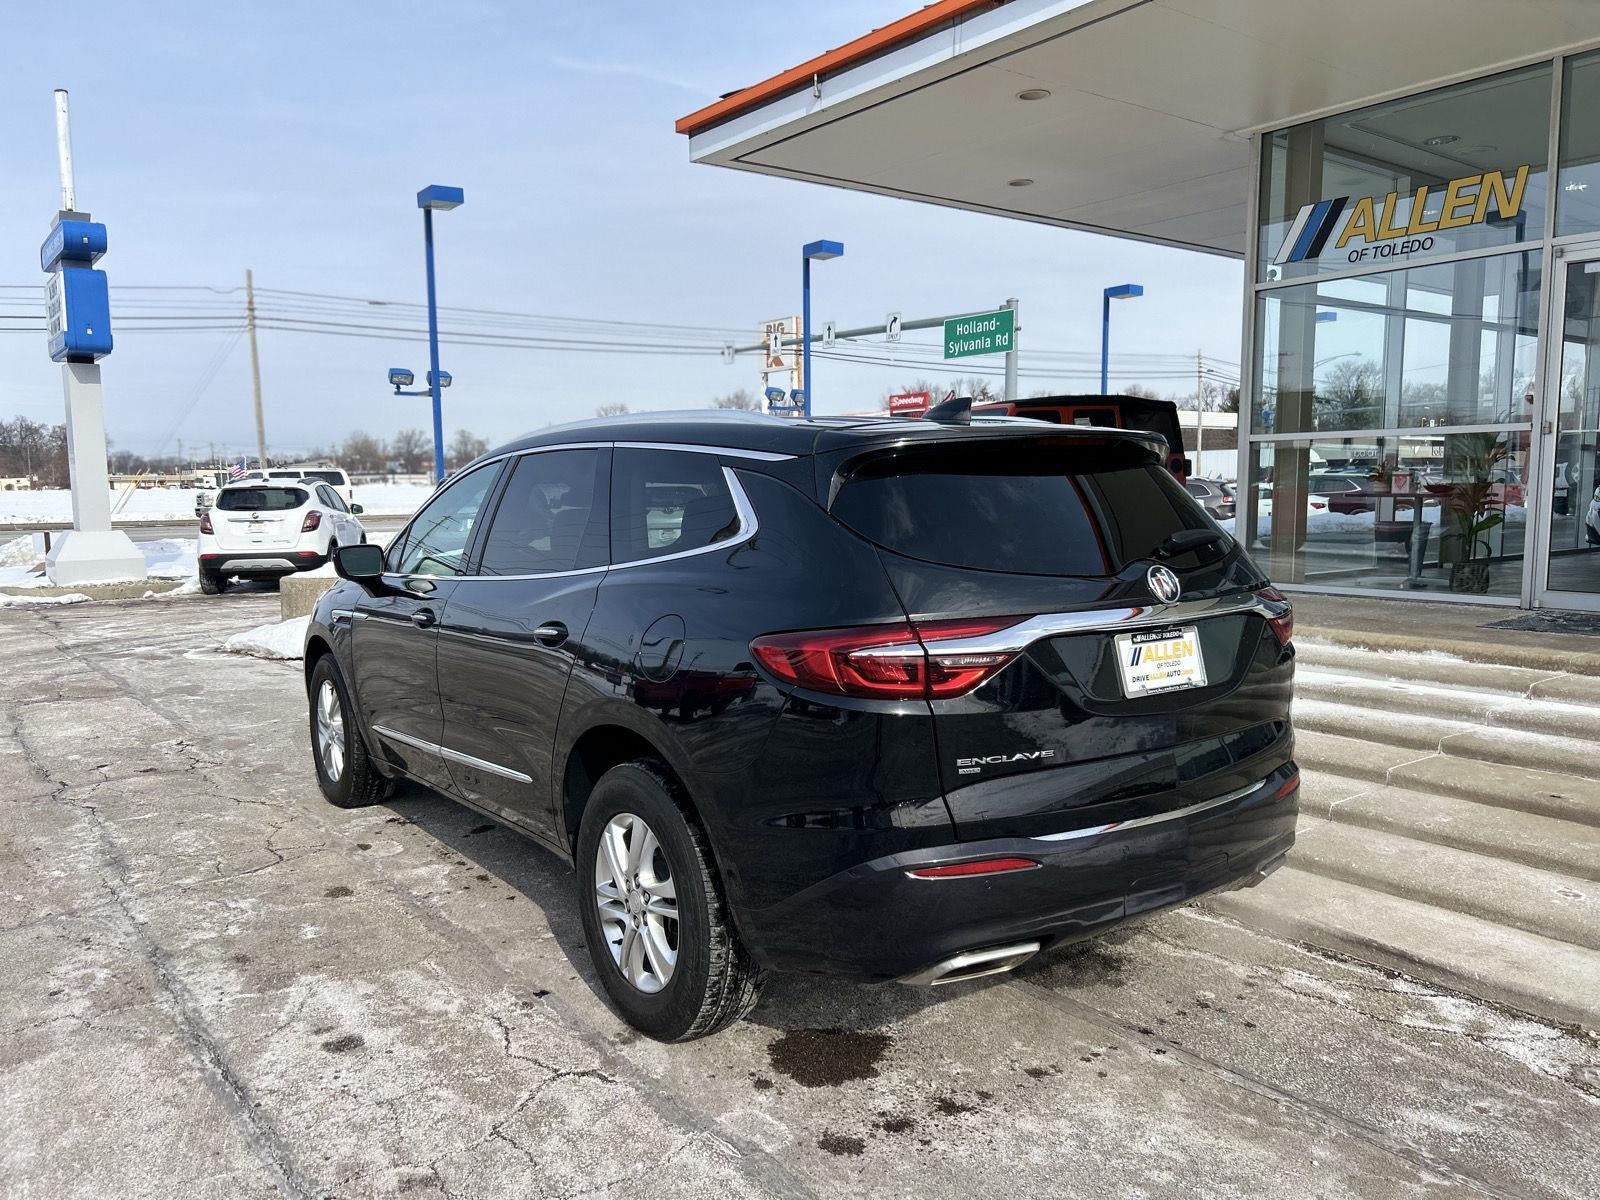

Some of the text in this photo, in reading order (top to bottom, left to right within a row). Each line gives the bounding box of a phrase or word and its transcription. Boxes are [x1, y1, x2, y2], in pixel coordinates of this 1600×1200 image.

[1335, 165, 1530, 249] ALLEN
[1348, 237, 1434, 263] OF TOLEDO
[956, 318, 1000, 336] Holland-
[949, 333, 1009, 356] Sylvania Rd
[891, 396, 925, 407] Speedway
[1141, 633, 1157, 641] ALLEN
[1143, 640, 1193, 662] ALLEN
[1164, 660, 1181, 668] TOLEDO
[956, 749, 1055, 767] ENCLAVE
